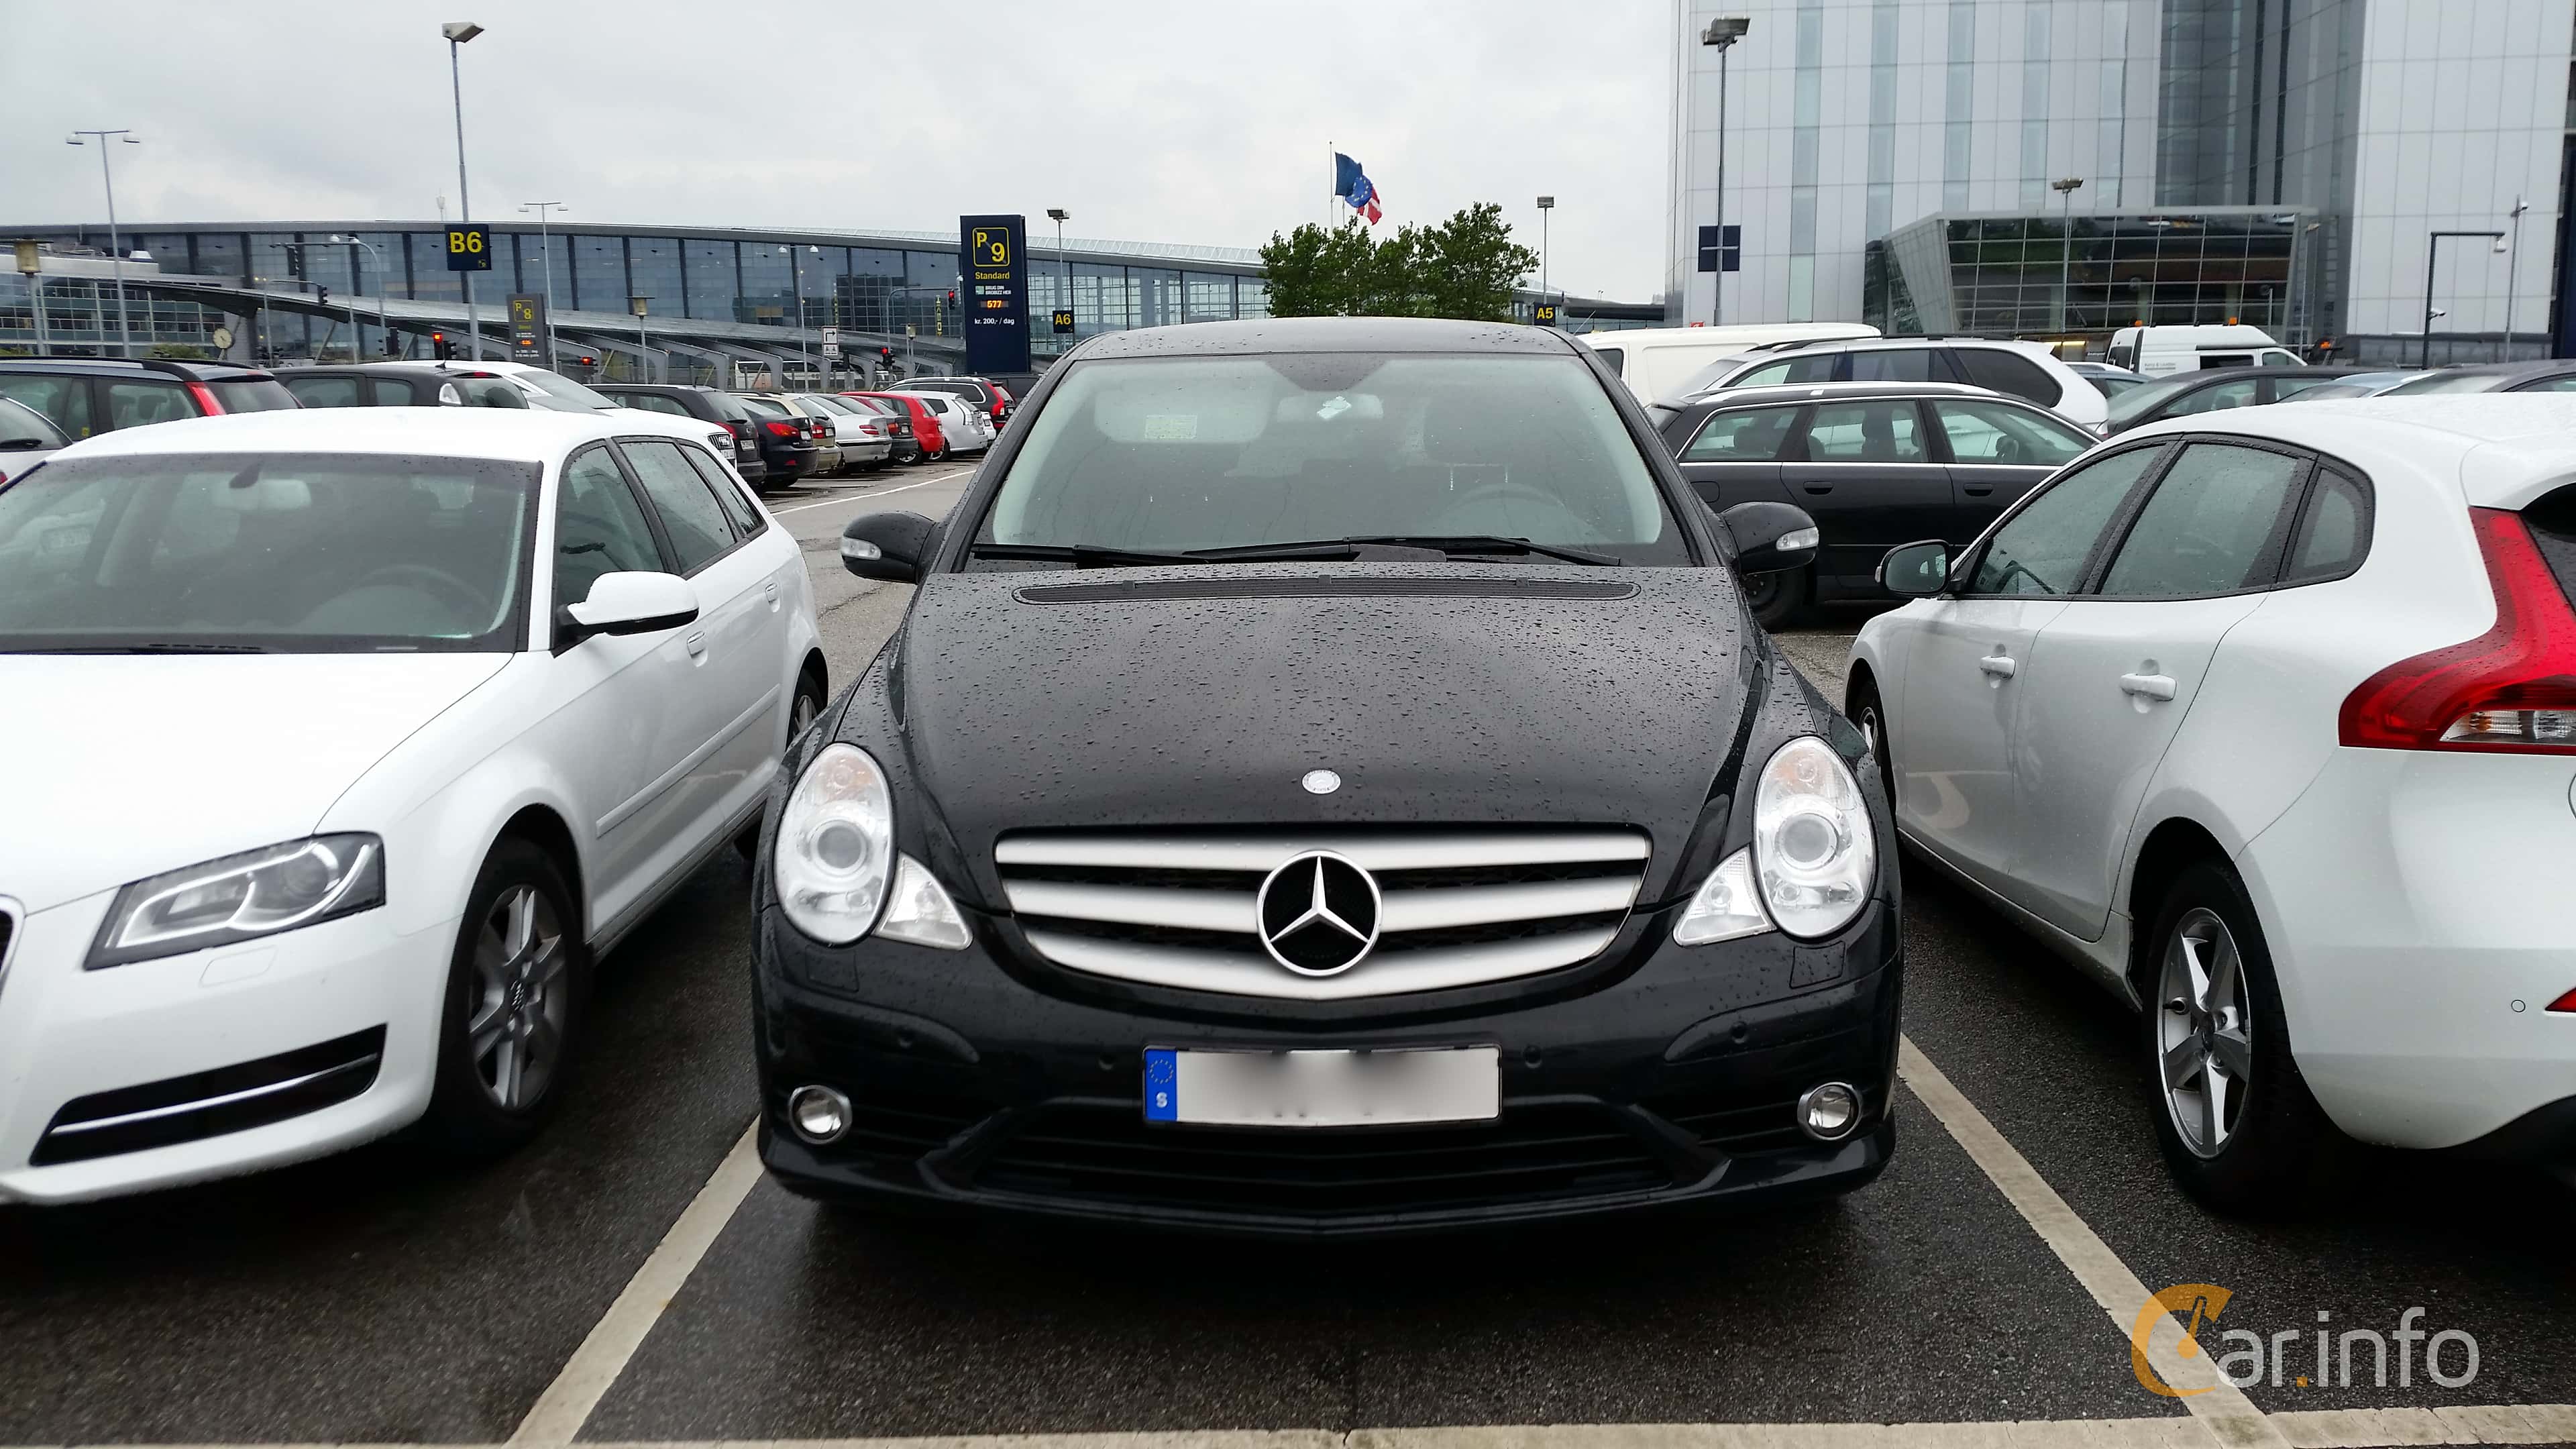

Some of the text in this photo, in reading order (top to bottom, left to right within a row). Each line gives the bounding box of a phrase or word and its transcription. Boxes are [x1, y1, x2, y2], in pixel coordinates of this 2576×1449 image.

[450, 231, 482, 253] B6
[976, 232, 1005, 262] P 9
[975, 271, 1010, 279] Standard
[515, 303, 532, 319] P 8
[987, 300, 1002, 308] 577
[1055, 313, 1071, 325] A6
[1536, 307, 1554, 319] A5
[1156, 1091, 1167, 1108] S
